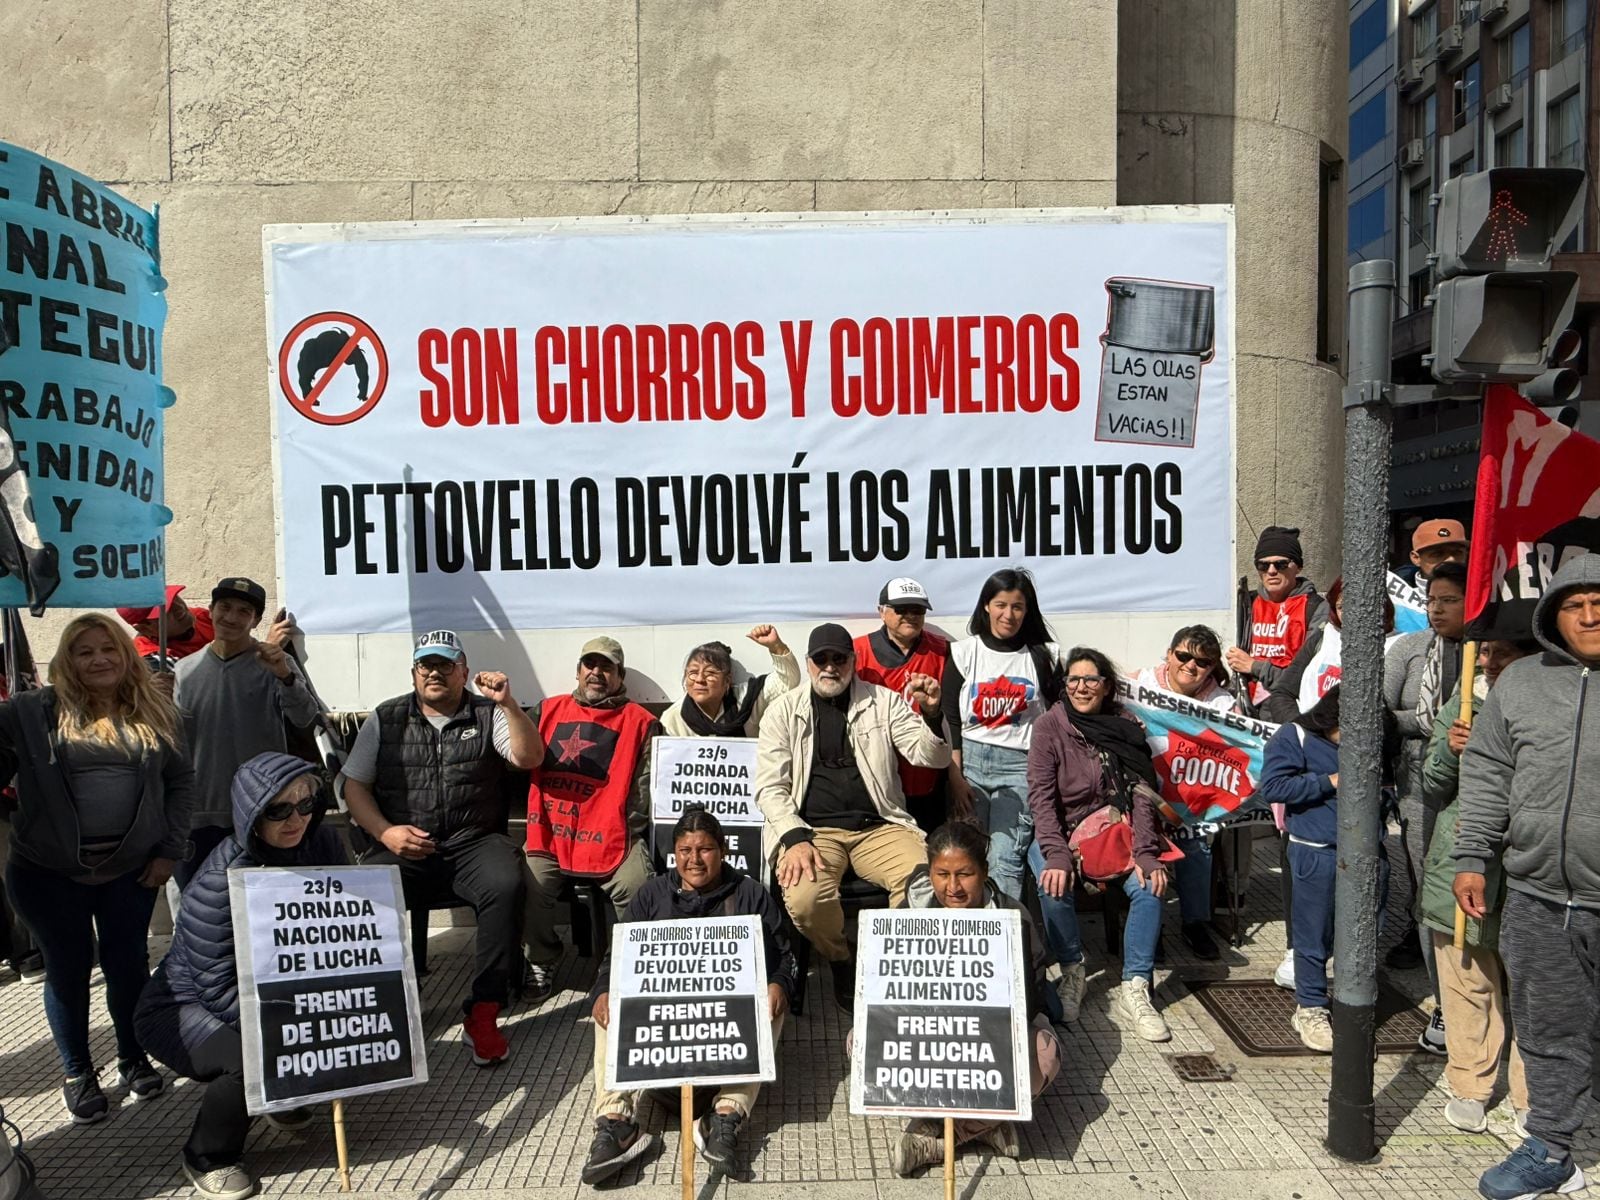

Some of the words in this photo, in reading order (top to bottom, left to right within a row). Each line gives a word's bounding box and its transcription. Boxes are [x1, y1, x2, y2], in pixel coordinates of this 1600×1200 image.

[418, 327, 519, 427] SON
[534, 321, 766, 425] CHORROS
[779, 320, 813, 417] Y
[830, 312, 1080, 417] COIMEROS
[1111, 352, 1146, 377] LAS
[1153, 359, 1196, 380] OLLAS
[1117, 383, 1168, 402] ESTAN
[53, 495, 82, 532] Y
[321, 476, 601, 575] PETTOVELLO
[616, 452, 812, 568] DEVOLVÉ
[827, 469, 910, 561] LOS
[925, 462, 1182, 559] ALIMENTOS
[1138, 686, 1221, 723] PRESENTE
[1225, 712, 1247, 732] ES
[1251, 721, 1275, 740] DE
[698, 745, 728, 762] 23/9
[674, 763, 749, 778] JORNADA
[1171, 755, 1242, 797] COOKE
[671, 781, 751, 797] NACIONAL
[557, 801, 579, 817] LA
[303, 876, 343, 898] 23/9
[275, 899, 375, 921] JORNADA
[273, 923, 382, 946] NACIONAL
[630, 928, 648, 942] SON
[651, 926, 692, 942] CHORROS
[695, 926, 701, 940] Y
[704, 925, 749, 940] COIMEROS
[872, 919, 892, 936] SON
[895, 918, 939, 936] CHORROS
[942, 920, 949, 936] Y
[951, 919, 1001, 936] COIMEROS
[639, 941, 738, 957] PETTOVELLO
[883, 938, 989, 956] PETTOVELLO
[278, 953, 305, 973] DE
[314, 947, 382, 970] LUCHA
[634, 956, 706, 974] DEVOLVÉ
[712, 958, 742, 973] LOS
[879, 956, 955, 977] DEVOLVÉ
[962, 960, 994, 978] LOS
[640, 976, 736, 993] ALIMENTOS
[884, 981, 987, 1001] ALIMENTOS
[294, 986, 377, 1015] FRENTE
[649, 1001, 727, 1021] FRENTE
[282, 1022, 313, 1046] DE
[320, 1012, 393, 1040] LUCHA
[635, 1025, 663, 1043] DE
[670, 1021, 741, 1041] LUCHA
[897, 1016, 980, 1036] FRENTE
[276, 1039, 400, 1078] PIQUETERO
[628, 1043, 748, 1067] PIQUETERO
[883, 1041, 912, 1061] DE
[918, 1042, 995, 1063] LUCHA
[876, 1067, 1002, 1091] PIQUETERO
